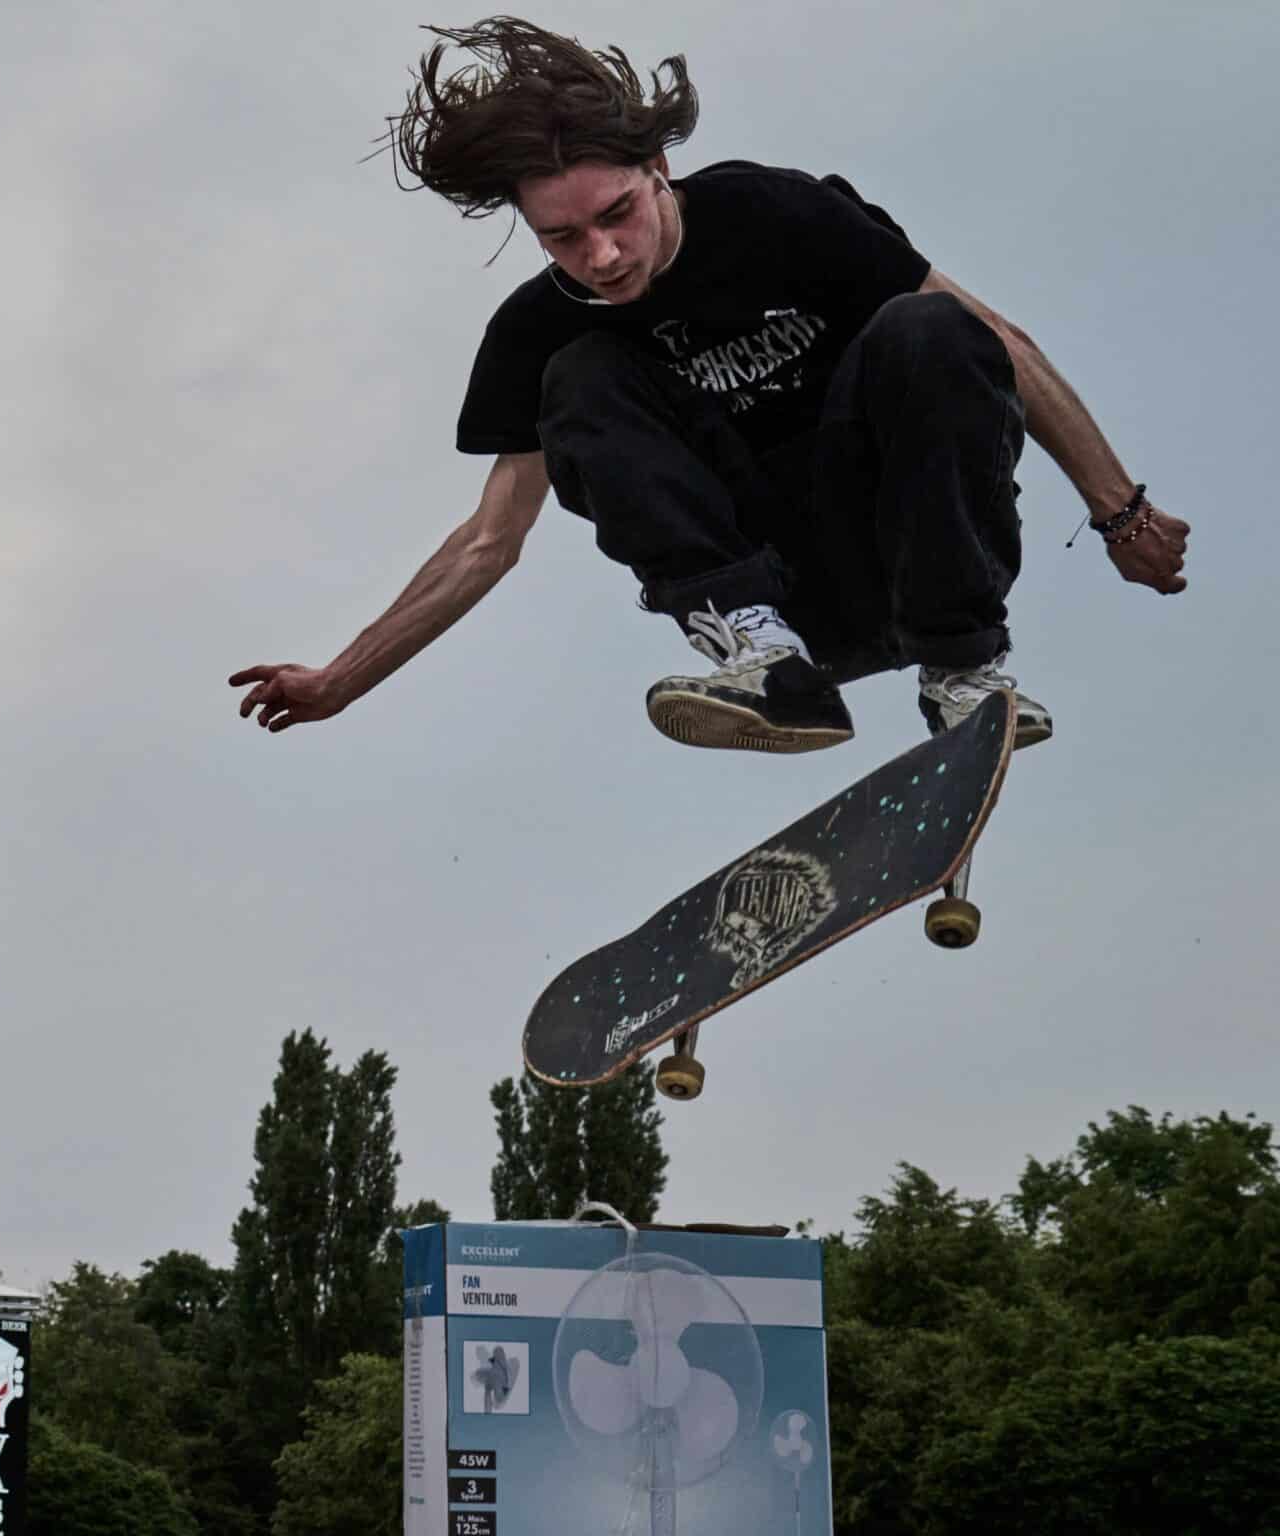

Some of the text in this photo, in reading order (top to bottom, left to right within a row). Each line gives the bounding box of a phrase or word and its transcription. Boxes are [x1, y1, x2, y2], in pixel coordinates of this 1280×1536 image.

[462, 1275, 480, 1289] FAN
[462, 1292, 518, 1307] VENTILATOR
[1, 1320, 28, 1332] BEER
[459, 1455, 489, 1467] 45W
[467, 1480, 477, 1494] 3
